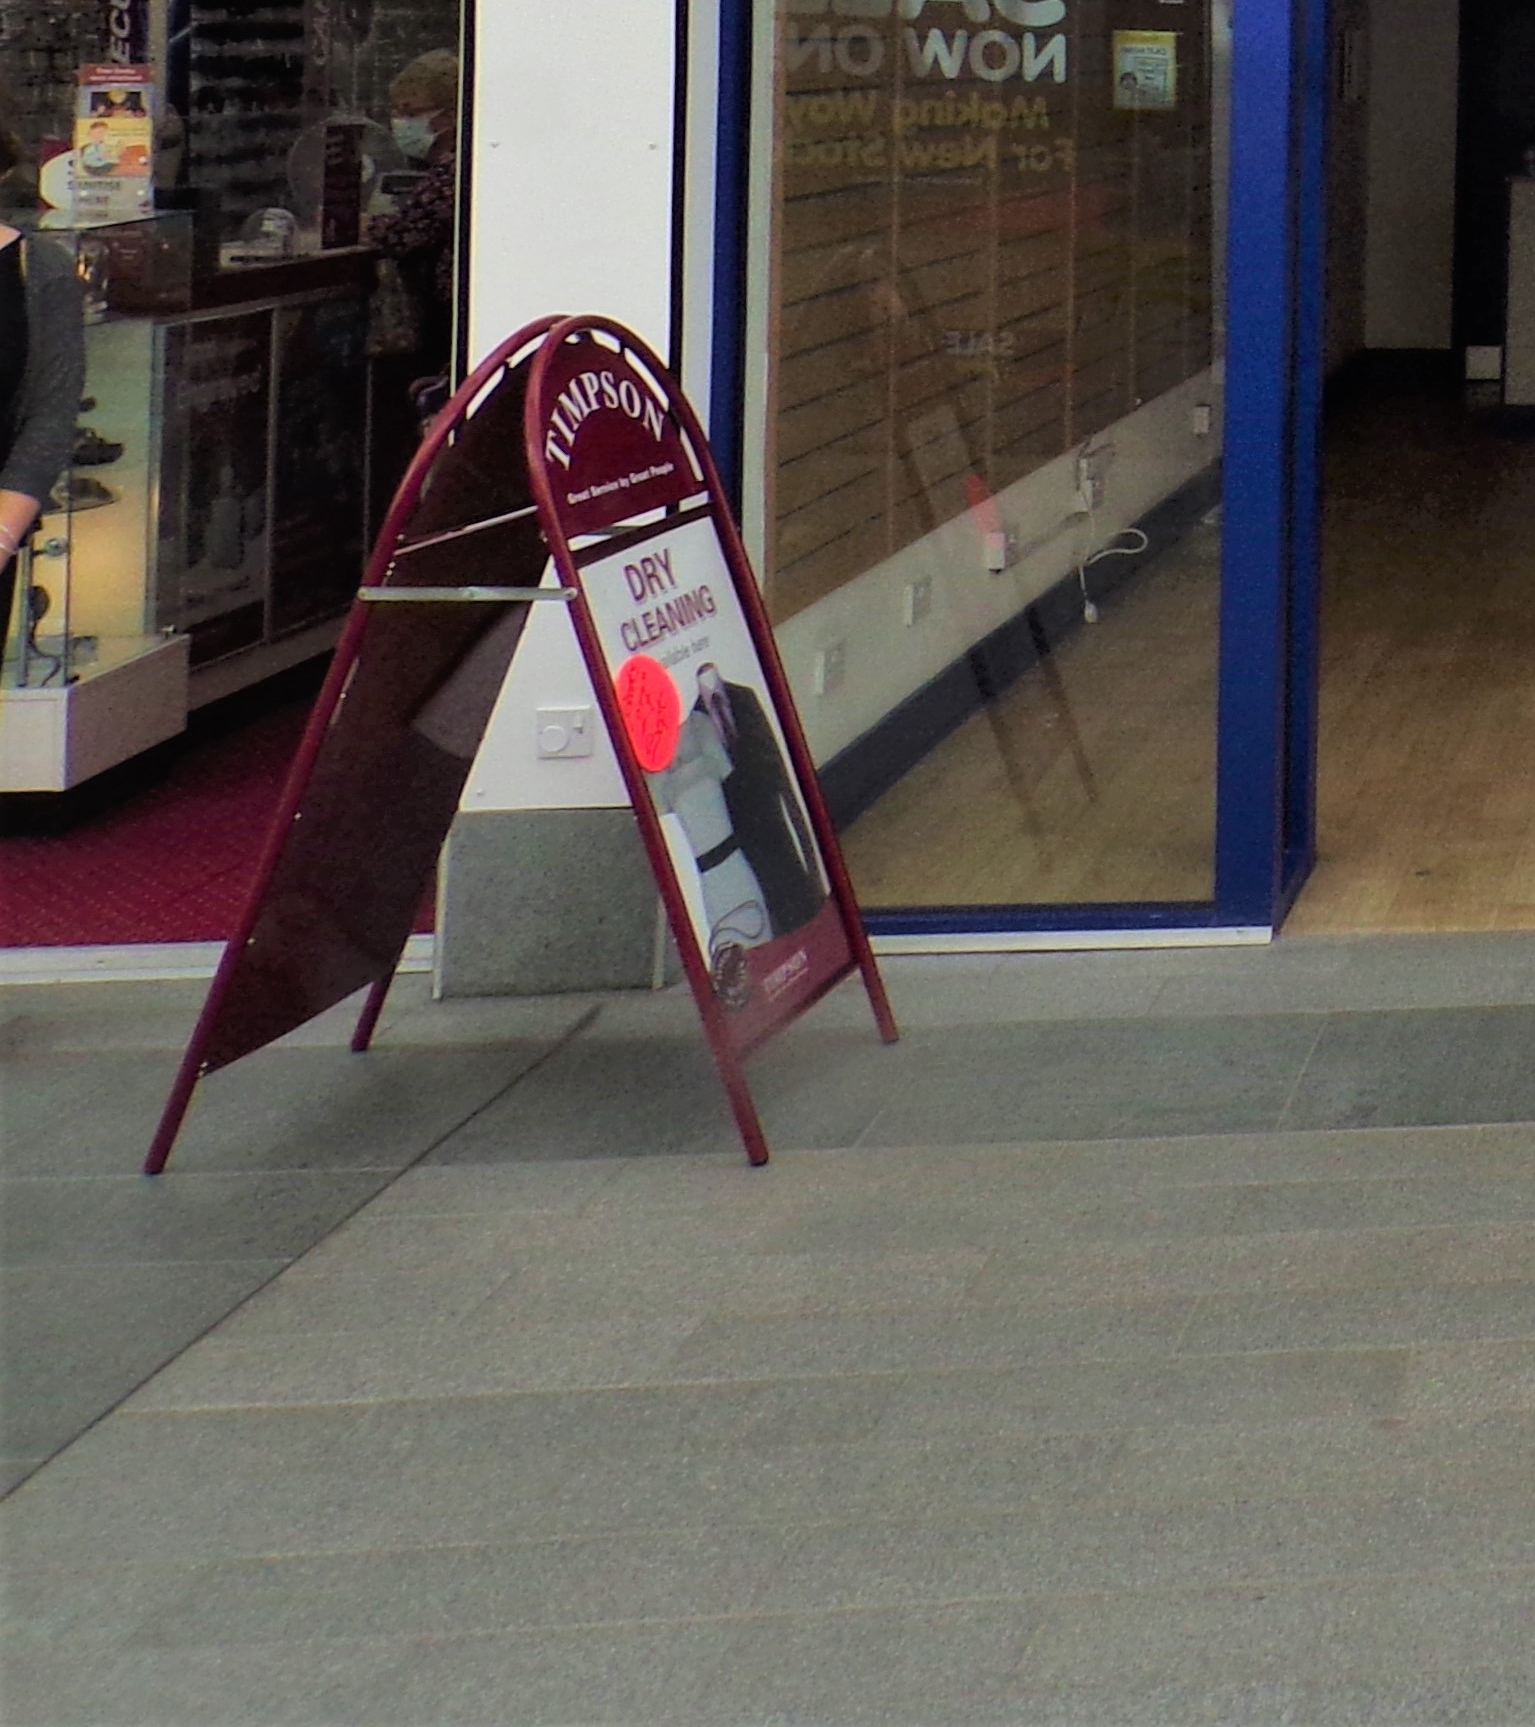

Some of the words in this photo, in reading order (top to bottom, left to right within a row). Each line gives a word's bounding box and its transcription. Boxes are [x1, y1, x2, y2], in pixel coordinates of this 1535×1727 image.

[545, 371, 665, 471] TIMPSON
[624, 549, 676, 602] DRY
[620, 585, 717, 652] CLEANING
